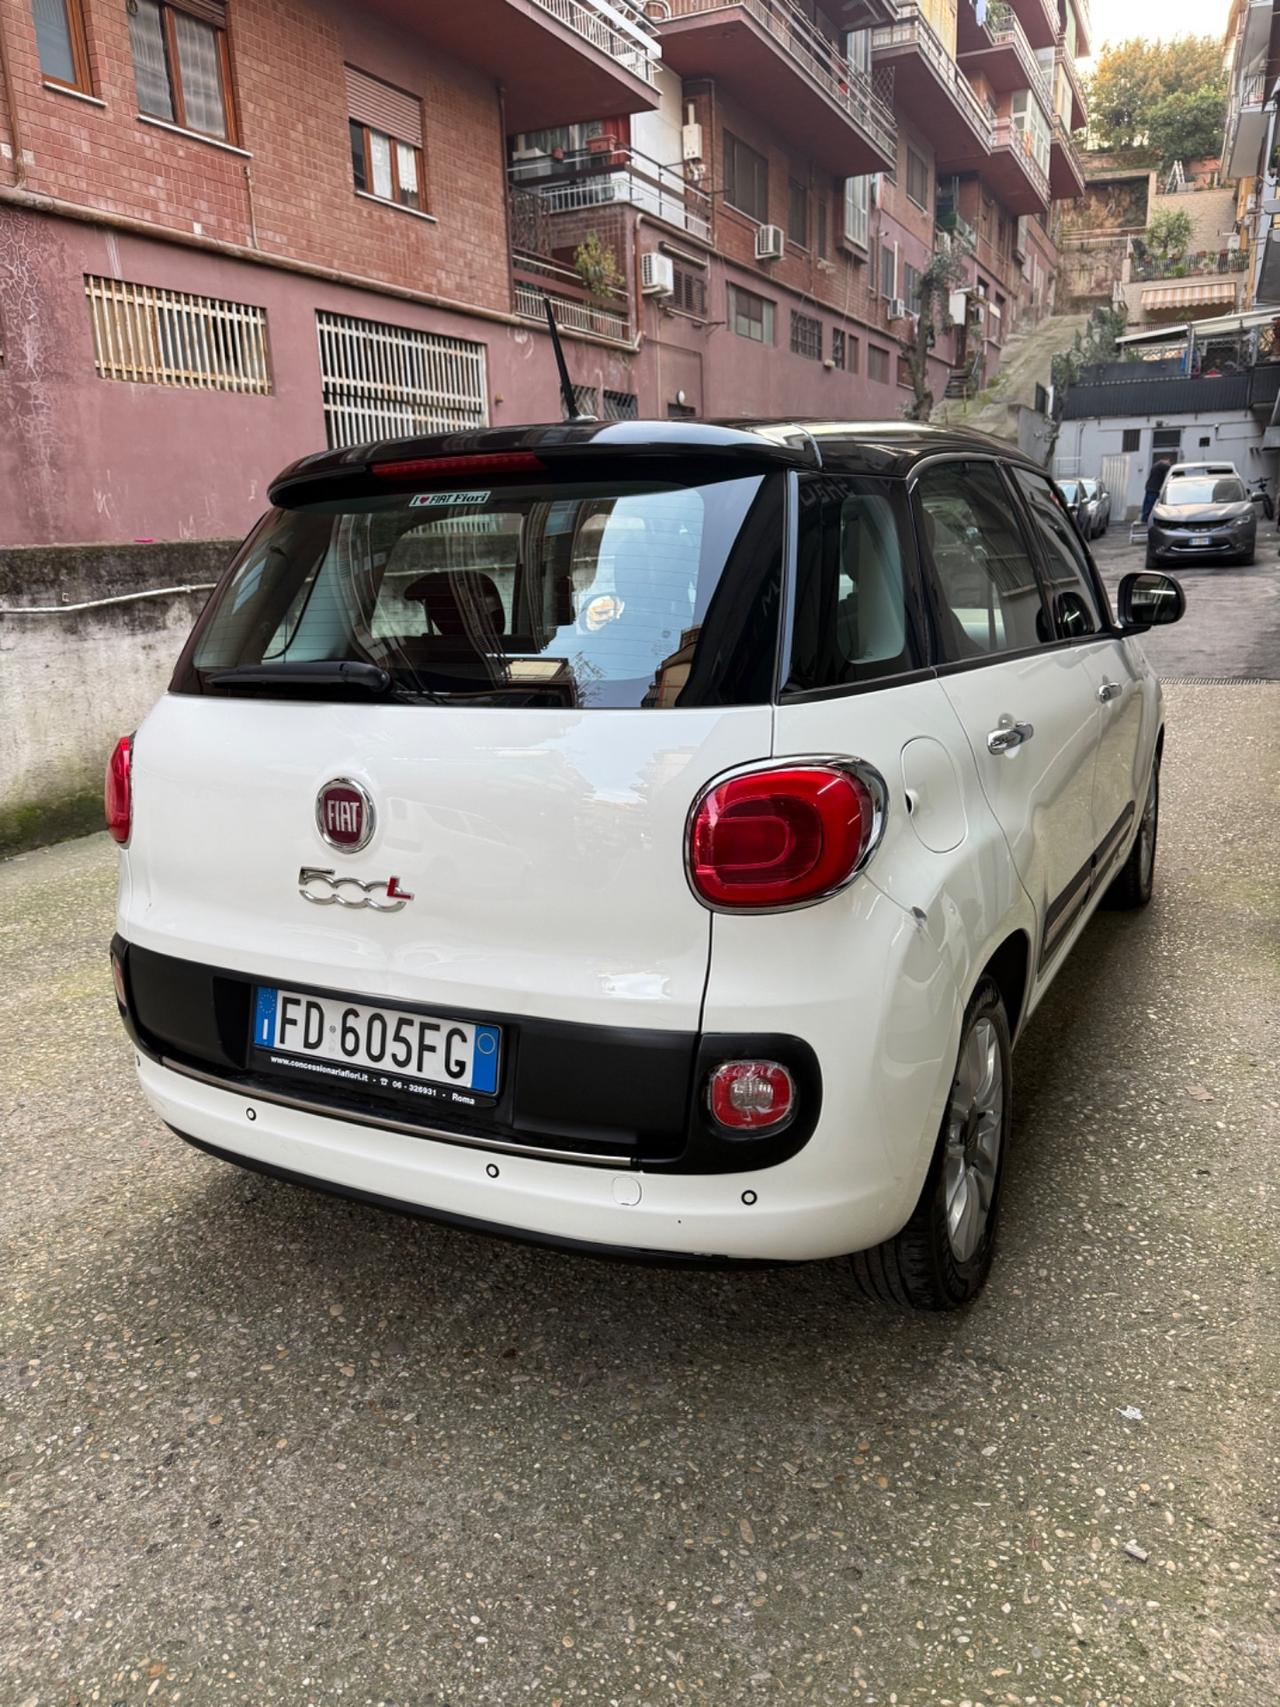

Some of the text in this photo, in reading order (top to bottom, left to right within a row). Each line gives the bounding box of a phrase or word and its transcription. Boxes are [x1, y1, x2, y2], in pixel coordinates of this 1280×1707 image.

[429, 494, 453, 504] FIAT
[453, 493, 488, 503] Fiori
[327, 799, 360, 833] FIAT
[298, 865, 415, 913] 500L
[279, 996, 325, 1050] FD
[340, 1007, 468, 1080] 605FG
[270, 1055, 369, 1082] www.concessionariafiori.it
[392, 1080, 402, 1089] 06
[451, 1092, 475, 1105] Roma
